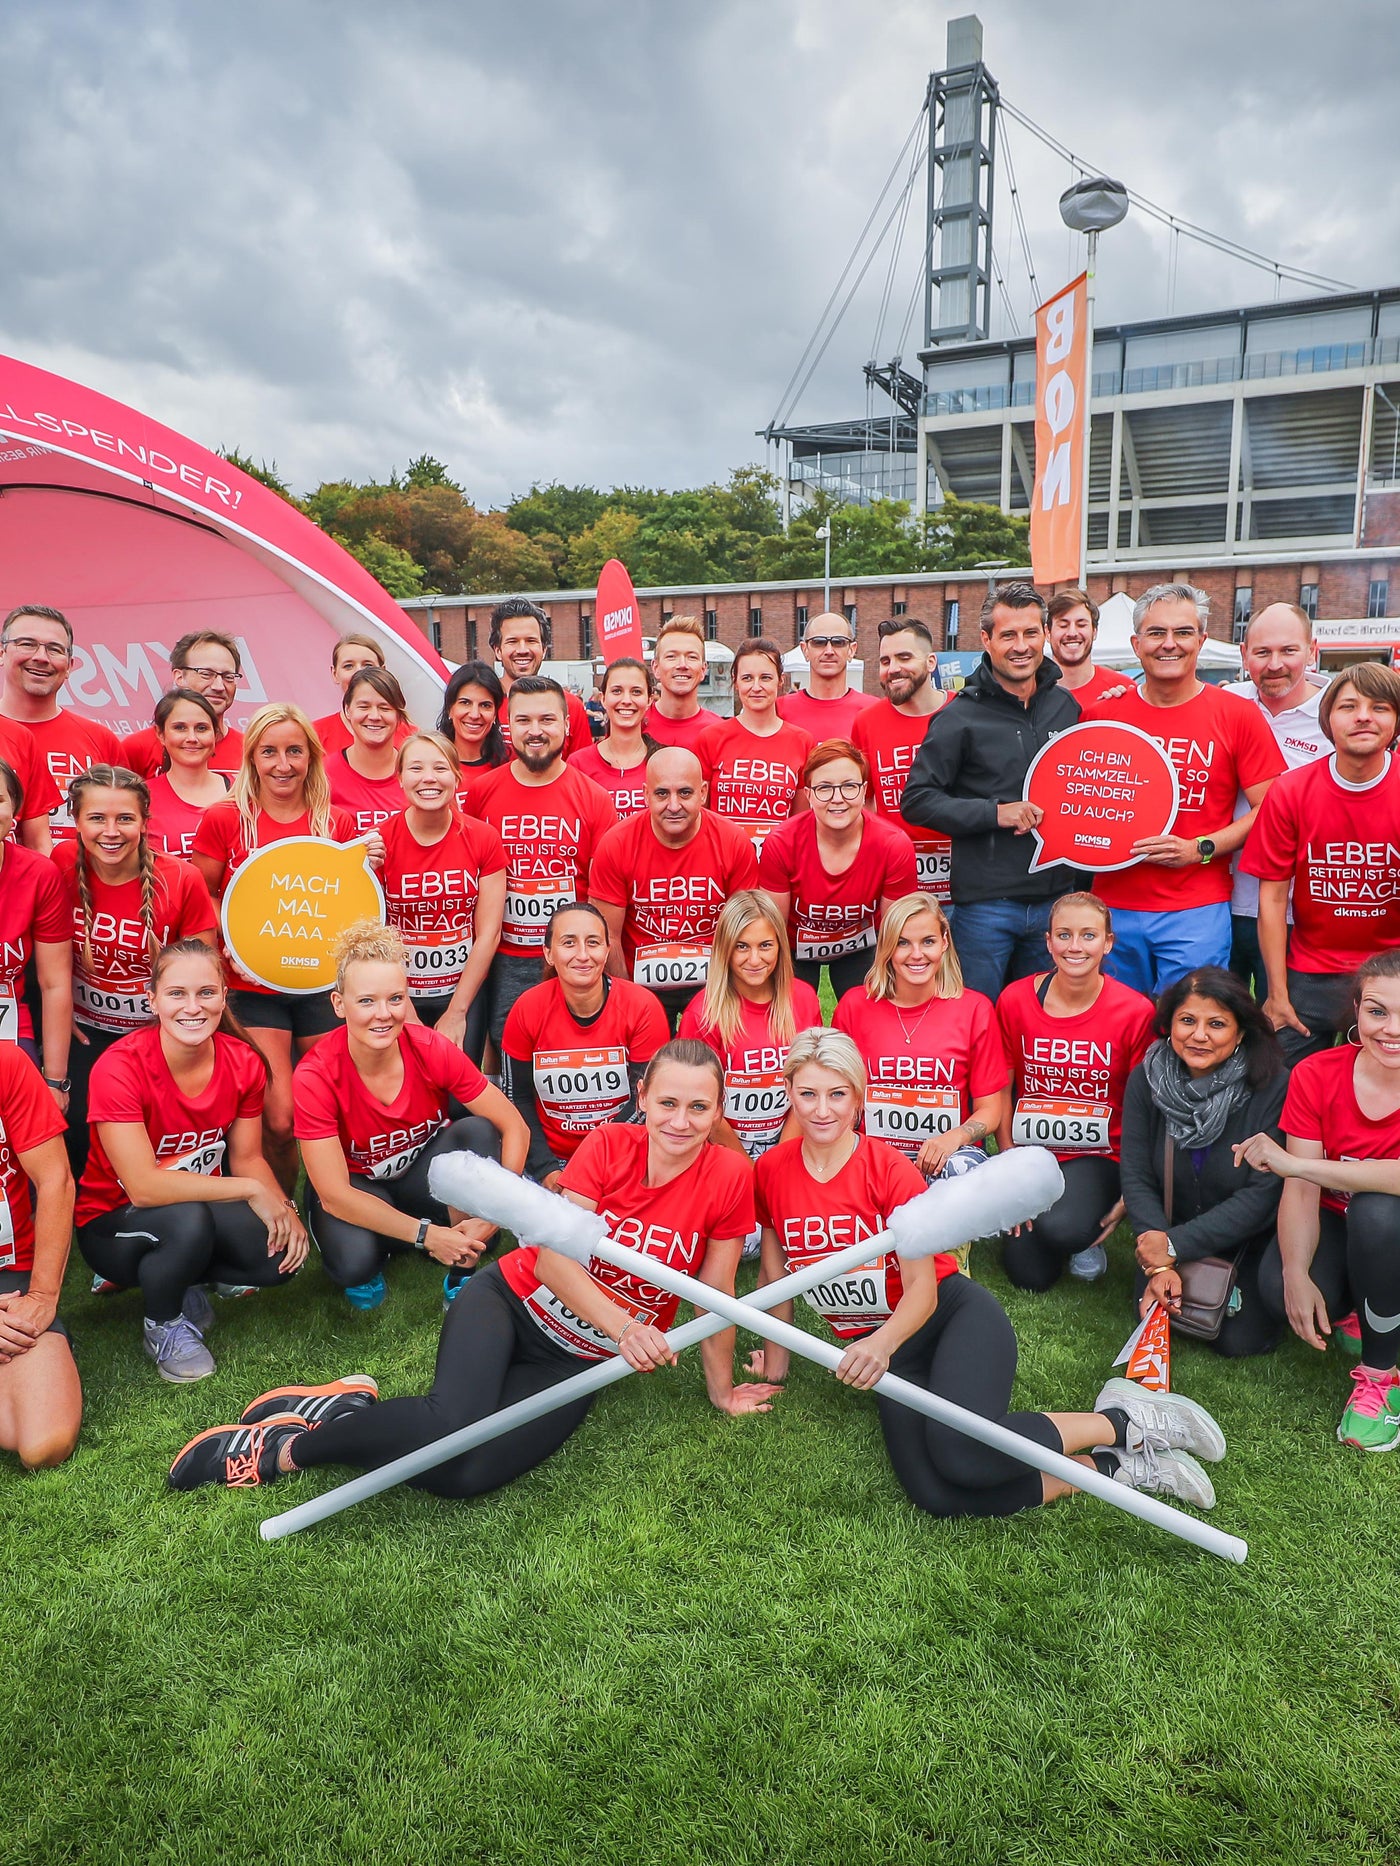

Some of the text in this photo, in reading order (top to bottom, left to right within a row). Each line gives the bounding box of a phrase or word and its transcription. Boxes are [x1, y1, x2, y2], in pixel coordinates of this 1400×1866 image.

[1079, 750, 1132, 766] ICH BIN
[718, 759, 799, 786] LEBEN
[880, 772, 910, 787] RETT
[1056, 765, 1150, 786] STAMMZELL-
[1186, 769, 1210, 783] SO
[718, 782, 762, 795] RETTEN
[766, 785, 784, 797] IST
[1066, 783, 1136, 801] SPENDER!
[1060, 802, 1135, 823] DU AUCH?
[486, 815, 580, 843] EBEN
[538, 844, 557, 856] IST
[559, 845, 578, 857] SO
[506, 858, 578, 877] NFACH
[1309, 866, 1400, 880] RETTEN IST S
[271, 873, 340, 895] MACH
[384, 868, 480, 899] LEBEN
[632, 876, 726, 902] LEBEN
[277, 898, 328, 918] MAL
[386, 900, 438, 913] RETTEN
[442, 899, 462, 911] IST
[685, 905, 706, 917] IST
[795, 897, 877, 920] LEBEN
[1334, 907, 1387, 918] dkms.de
[73, 907, 170, 949] EBEN
[114, 949, 137, 962] IST
[804, 933, 869, 959] 10031
[727, 1046, 791, 1073] LEBE
[1021, 1034, 1112, 1066] LEBEN
[867, 1056, 955, 1082] LEBEN
[1068, 1067, 1087, 1079] IST
[1090, 1069, 1110, 1081] SO
[542, 1071, 621, 1094] 10019
[1024, 1074, 1109, 1099] EINFACH
[730, 1090, 790, 1112] 1002
[351, 1109, 442, 1153] LEBEN
[873, 1109, 952, 1134] 10040
[1021, 1118, 1101, 1143] 10035
[600, 1209, 699, 1264] BEN
[772, 1214, 884, 1251] EBEN
[807, 1278, 878, 1307] 10050
